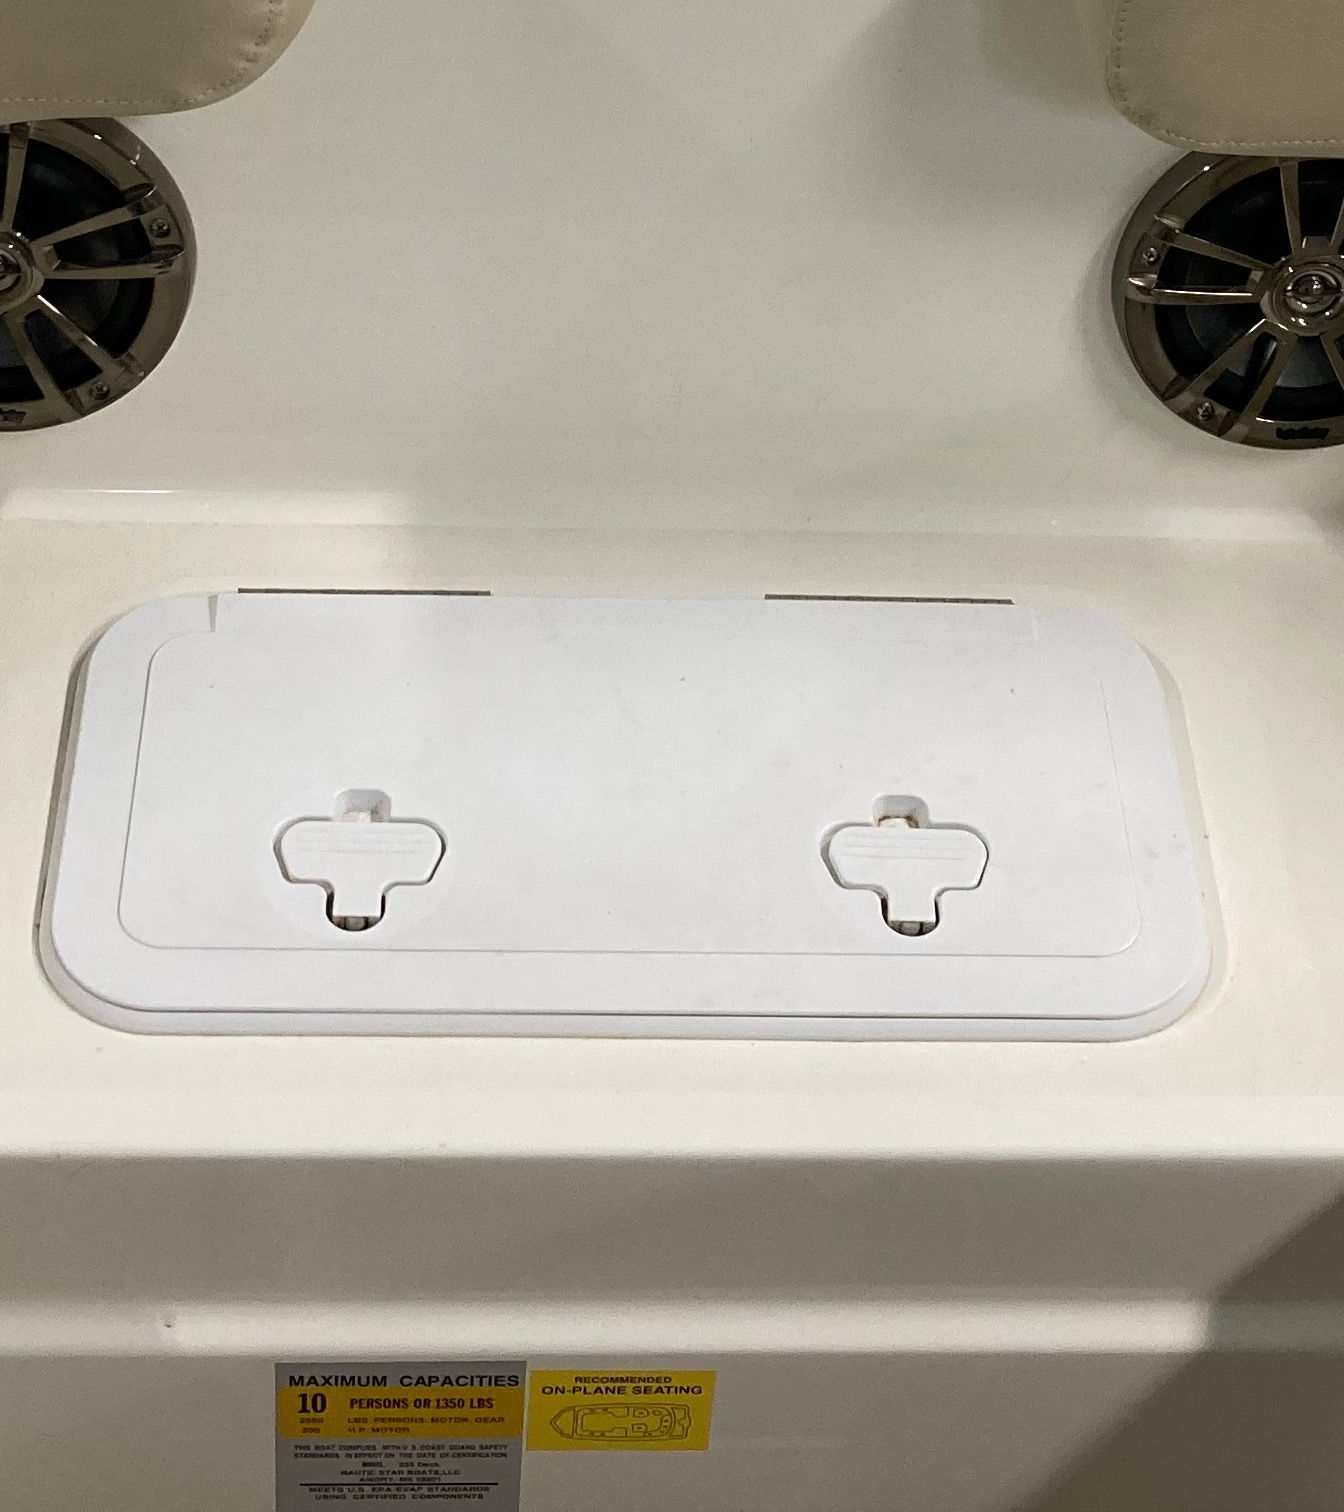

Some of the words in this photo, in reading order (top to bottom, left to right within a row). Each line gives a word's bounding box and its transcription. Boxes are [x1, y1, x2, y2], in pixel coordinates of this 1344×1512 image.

[288, 1374, 388, 1387] MAXIMUM
[399, 1374, 520, 1387] CAPACITIES
[574, 1375, 672, 1384] RECOMMENDED
[541, 1385, 627, 1396] ON-PLANE
[632, 1385, 703, 1396] SEATING
[298, 1392, 327, 1414] 10
[349, 1397, 409, 1409] PERSONS
[413, 1397, 432, 1409] OR
[436, 1397, 465, 1409] 1350
[469, 1397, 495, 1409] LBS
